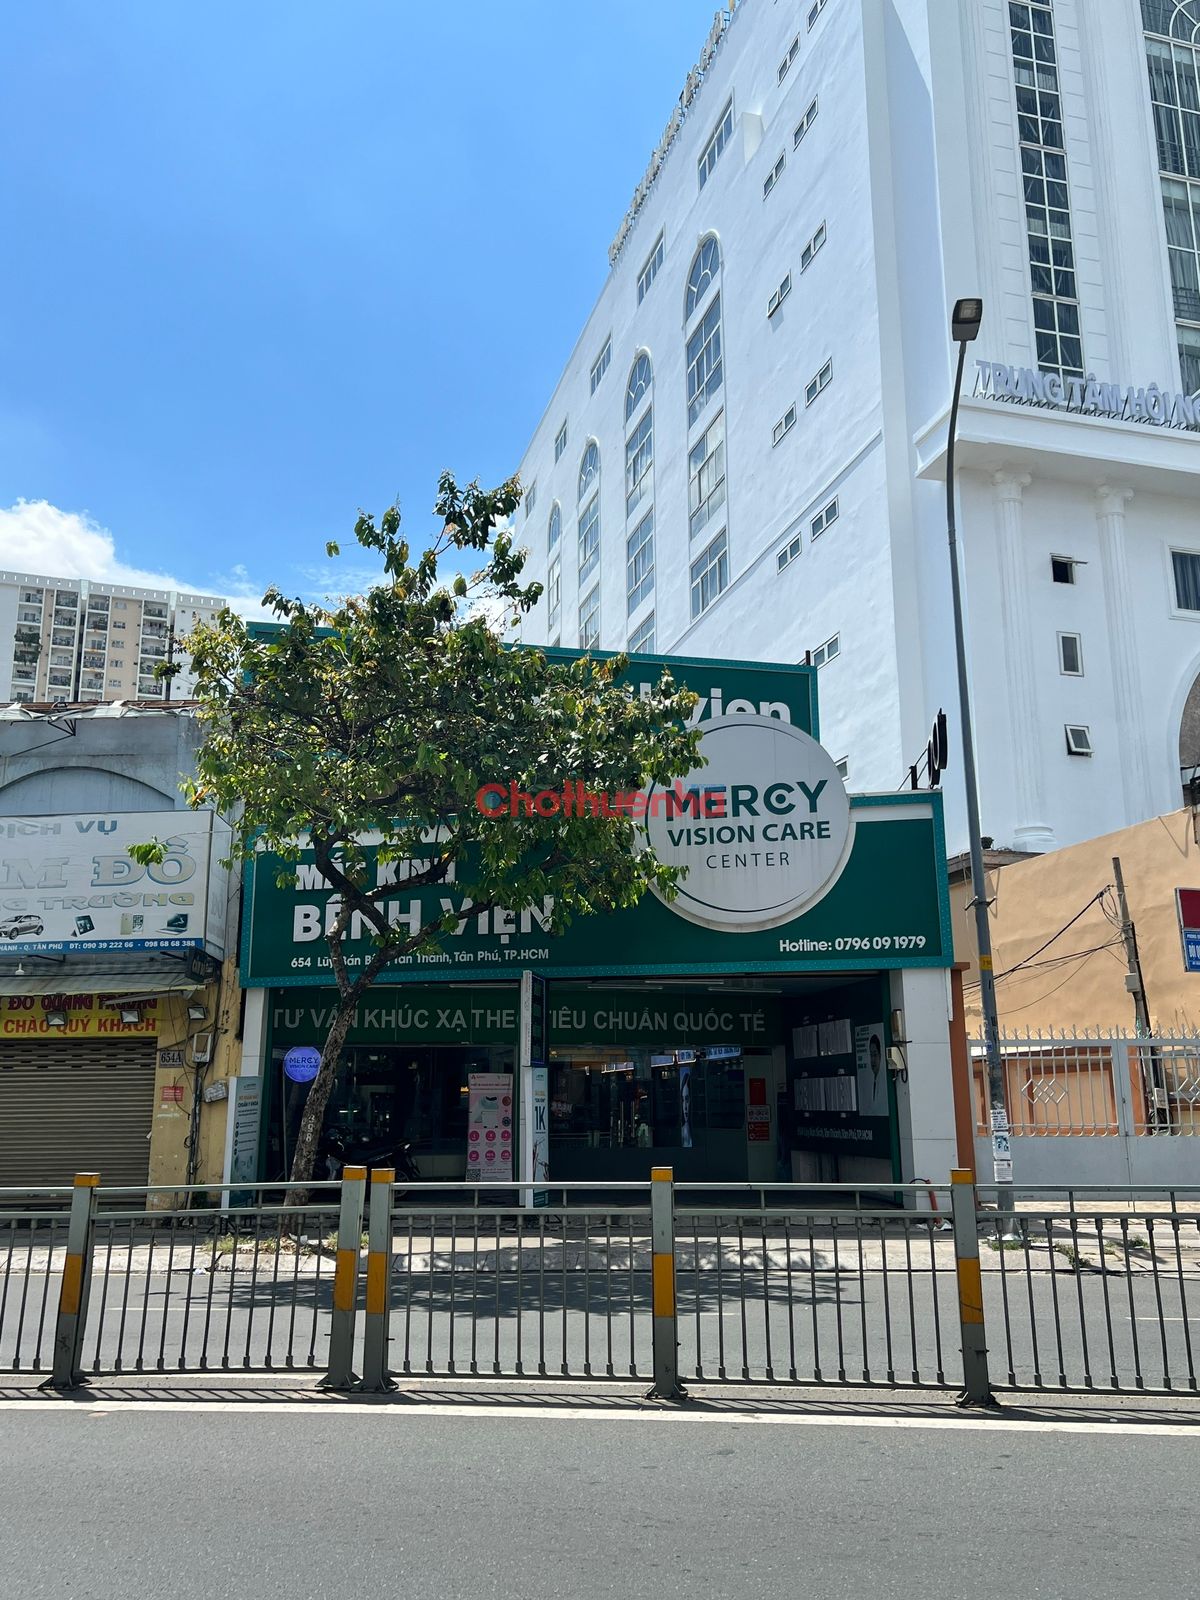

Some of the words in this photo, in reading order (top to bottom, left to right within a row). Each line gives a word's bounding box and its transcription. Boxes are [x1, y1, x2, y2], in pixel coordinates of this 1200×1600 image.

[974, 359, 1064, 404] TRUNG
[1066, 373, 1122, 414] TÂM
[665, 780, 829, 822] MERCY
[75, 819, 118, 836] VỤ
[667, 825, 755, 847] VISION
[762, 820, 831, 842] CARE
[91, 836, 196, 887] ĐỒ
[706, 852, 790, 869] CENTER
[82, 942, 97, 950] 090
[97, 941, 108, 949] 39
[108, 941, 123, 949] 222
[779, 939, 832, 952] Hotline:
[834, 938, 870, 950] 0796
[873, 936, 891, 949] 09
[893, 935, 926, 949] 1979
[290, 957, 312, 968] 654
[453, 951, 474, 962] Tân
[477, 949, 502, 963] Phú,
[503, 949, 549, 961] TP.HCM
[3, 1014, 50, 1034] CHÀO
[364, 1004, 430, 1029] KHÚC
[435, 1009, 468, 1033] XẠ
[471, 1009, 519, 1029] THE
[549, 1006, 587, 1030] IÊU
[594, 1007, 668, 1031] CHUẨN
[673, 1008, 733, 1032] QUỐC
[739, 1009, 766, 1032] TẾ
[161, 1052, 182, 1063] 654A
